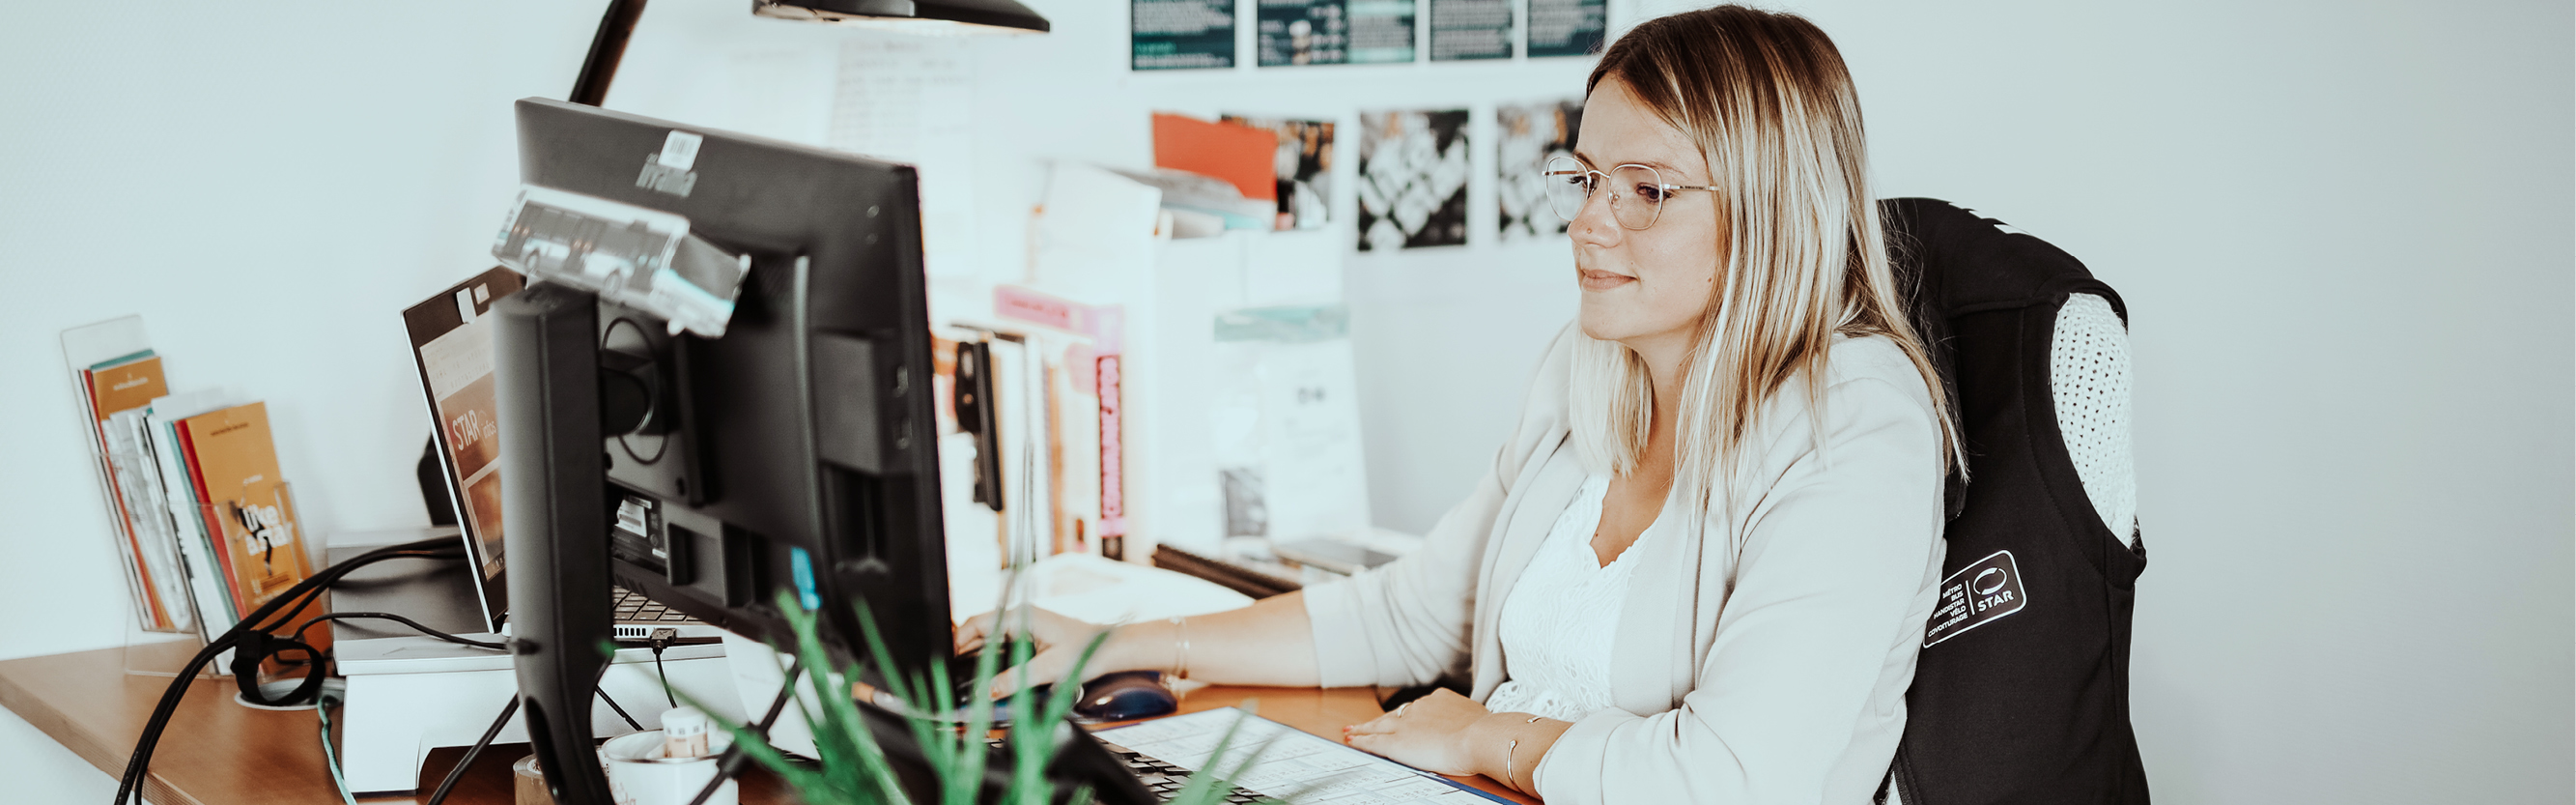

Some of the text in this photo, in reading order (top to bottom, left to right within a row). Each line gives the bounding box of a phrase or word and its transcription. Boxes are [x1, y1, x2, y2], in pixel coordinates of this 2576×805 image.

[452, 409, 481, 451] STAR
[1942, 584, 1962, 599] MÉTRO
[1951, 590, 1964, 602] BUS
[1977, 590, 2014, 612] STAR
[1934, 598, 1965, 619] HANDISTAR
[1949, 605, 1967, 618] VÉLO
[1928, 612, 1968, 638] COVOITURAGE
